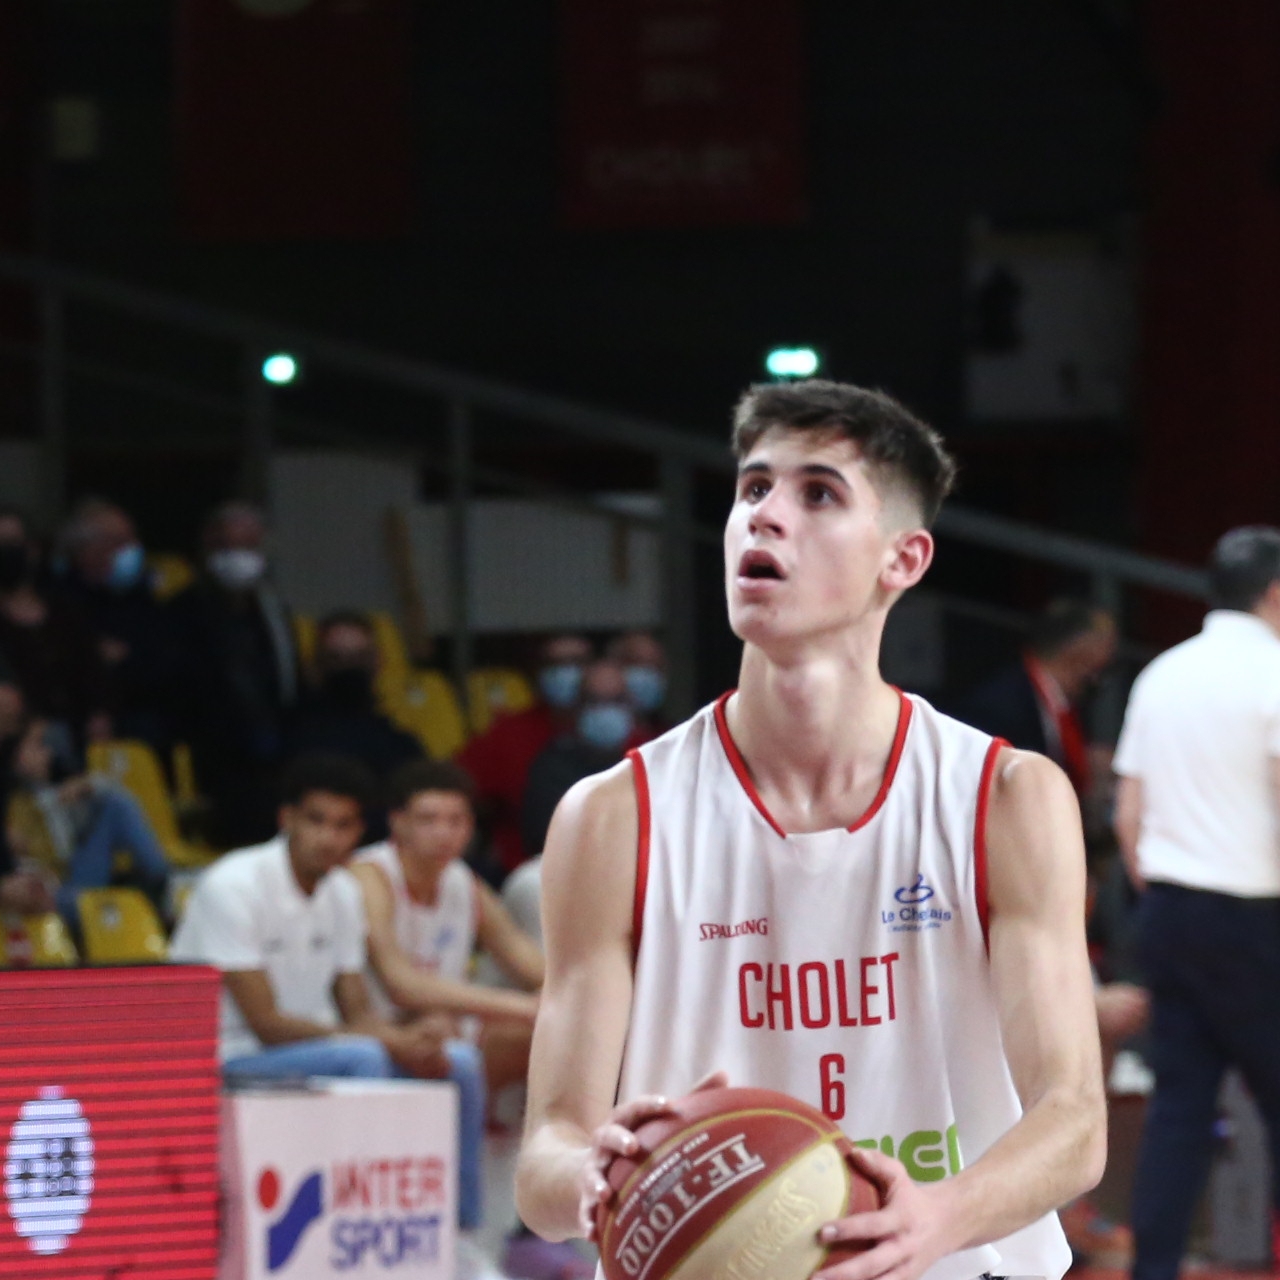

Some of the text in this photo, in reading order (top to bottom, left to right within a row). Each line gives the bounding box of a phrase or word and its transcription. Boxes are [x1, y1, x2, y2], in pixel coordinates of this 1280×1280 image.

[699, 917, 769, 941] SPALDING
[737, 952, 900, 1031] CHOLET
[819, 1053, 846, 1121] 6
[331, 1155, 447, 1209] INTER
[621, 1139, 763, 1277] TF-1000
[330, 1214, 442, 1271] SPORT
